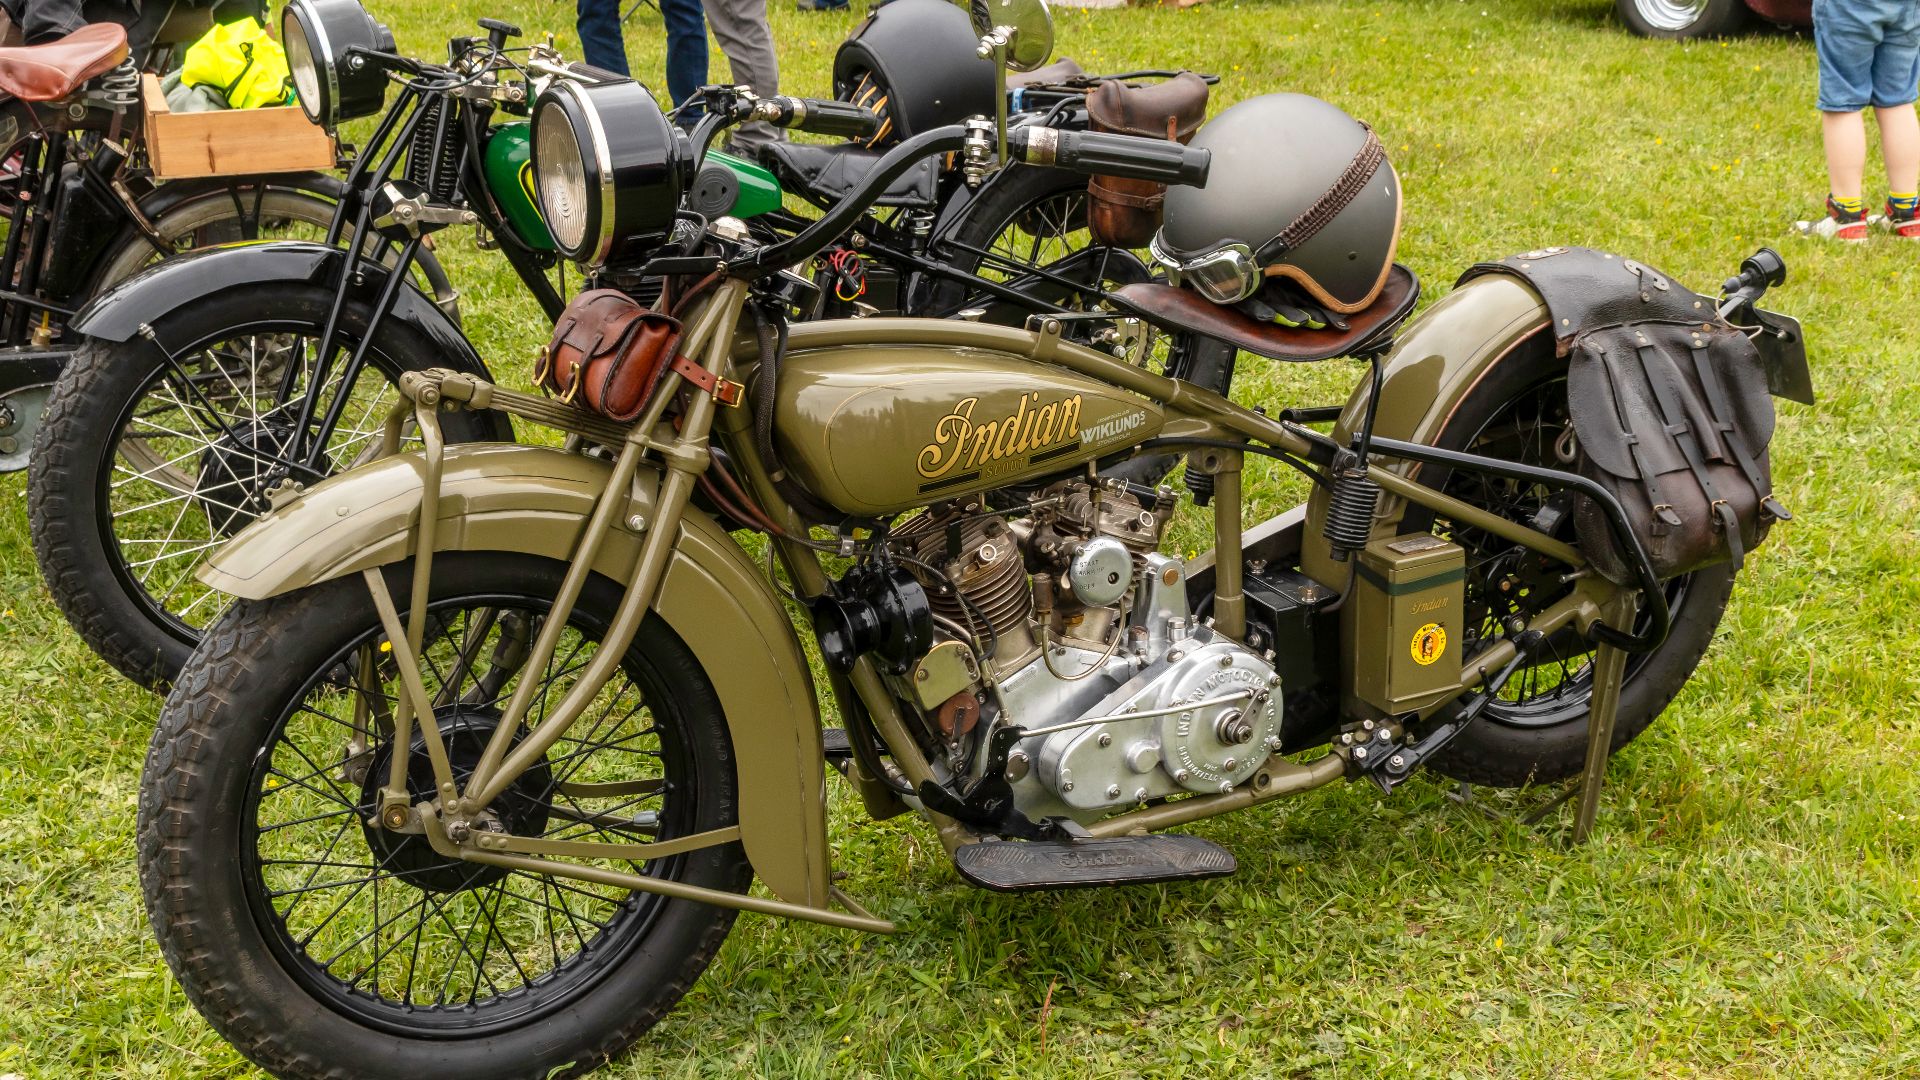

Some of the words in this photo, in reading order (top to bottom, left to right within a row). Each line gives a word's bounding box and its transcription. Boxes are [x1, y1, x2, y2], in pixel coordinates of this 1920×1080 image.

[916, 391, 1082, 479] Indian
[986, 457, 1026, 478] SCOUT
[1410, 597, 1449, 615] Indian
